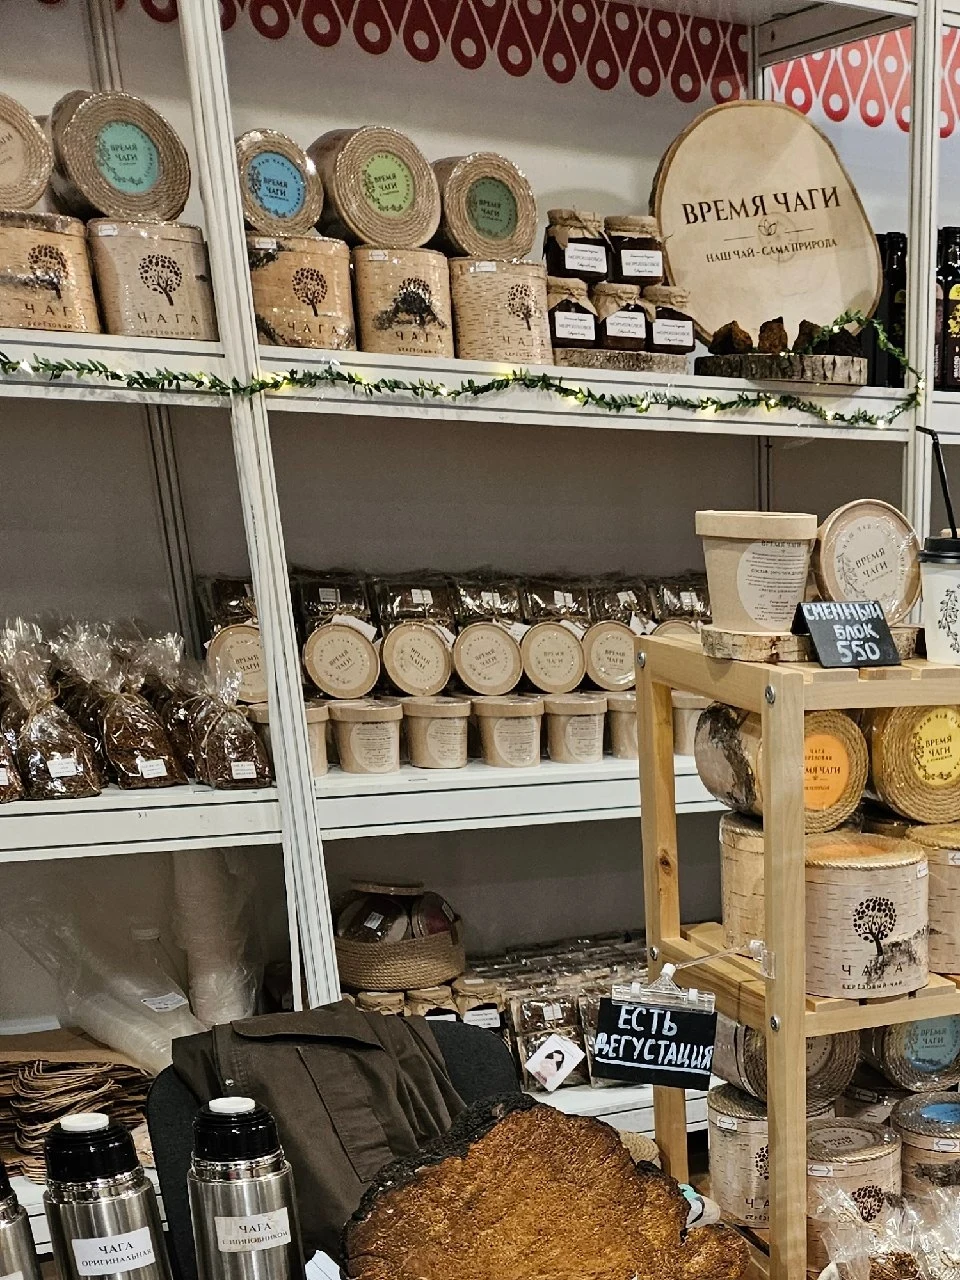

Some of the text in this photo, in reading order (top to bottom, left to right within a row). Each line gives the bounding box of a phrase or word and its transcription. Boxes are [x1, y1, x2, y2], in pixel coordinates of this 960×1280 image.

[681, 186, 842, 225] ВРЕМЯ ЧАГИ
[706, 251, 732, 263] НАШ
[733, 247, 756, 260] ЧАЙ
[761, 245, 790, 256] САМА
[791, 238, 838, 253] ПРИРОДА
[137, 312, 199, 325] ЧАГА
[287, 322, 338, 335] ЧАГА
[396, 331, 443, 344] ЧАГА
[855, 547, 886, 569] ВРЕМЯ
[862, 560, 889, 578] ЧАГИ
[833, 623, 880, 640] БЛОК
[836, 640, 881, 663] 550
[925, 734, 952, 748] ВРЕМЯ
[928, 746, 951, 757] ЧАГИ
[617, 1005, 678, 1036] ЕСТЬ
[594, 1032, 714, 1069] ДЕГУСТАЦИЯ
[239, 1222, 271, 1234] ЧАГА
[99, 1241, 135, 1254] ЧАГА
[81, 1248, 153, 1268] ОРИГИНАЛЬНАЯ
